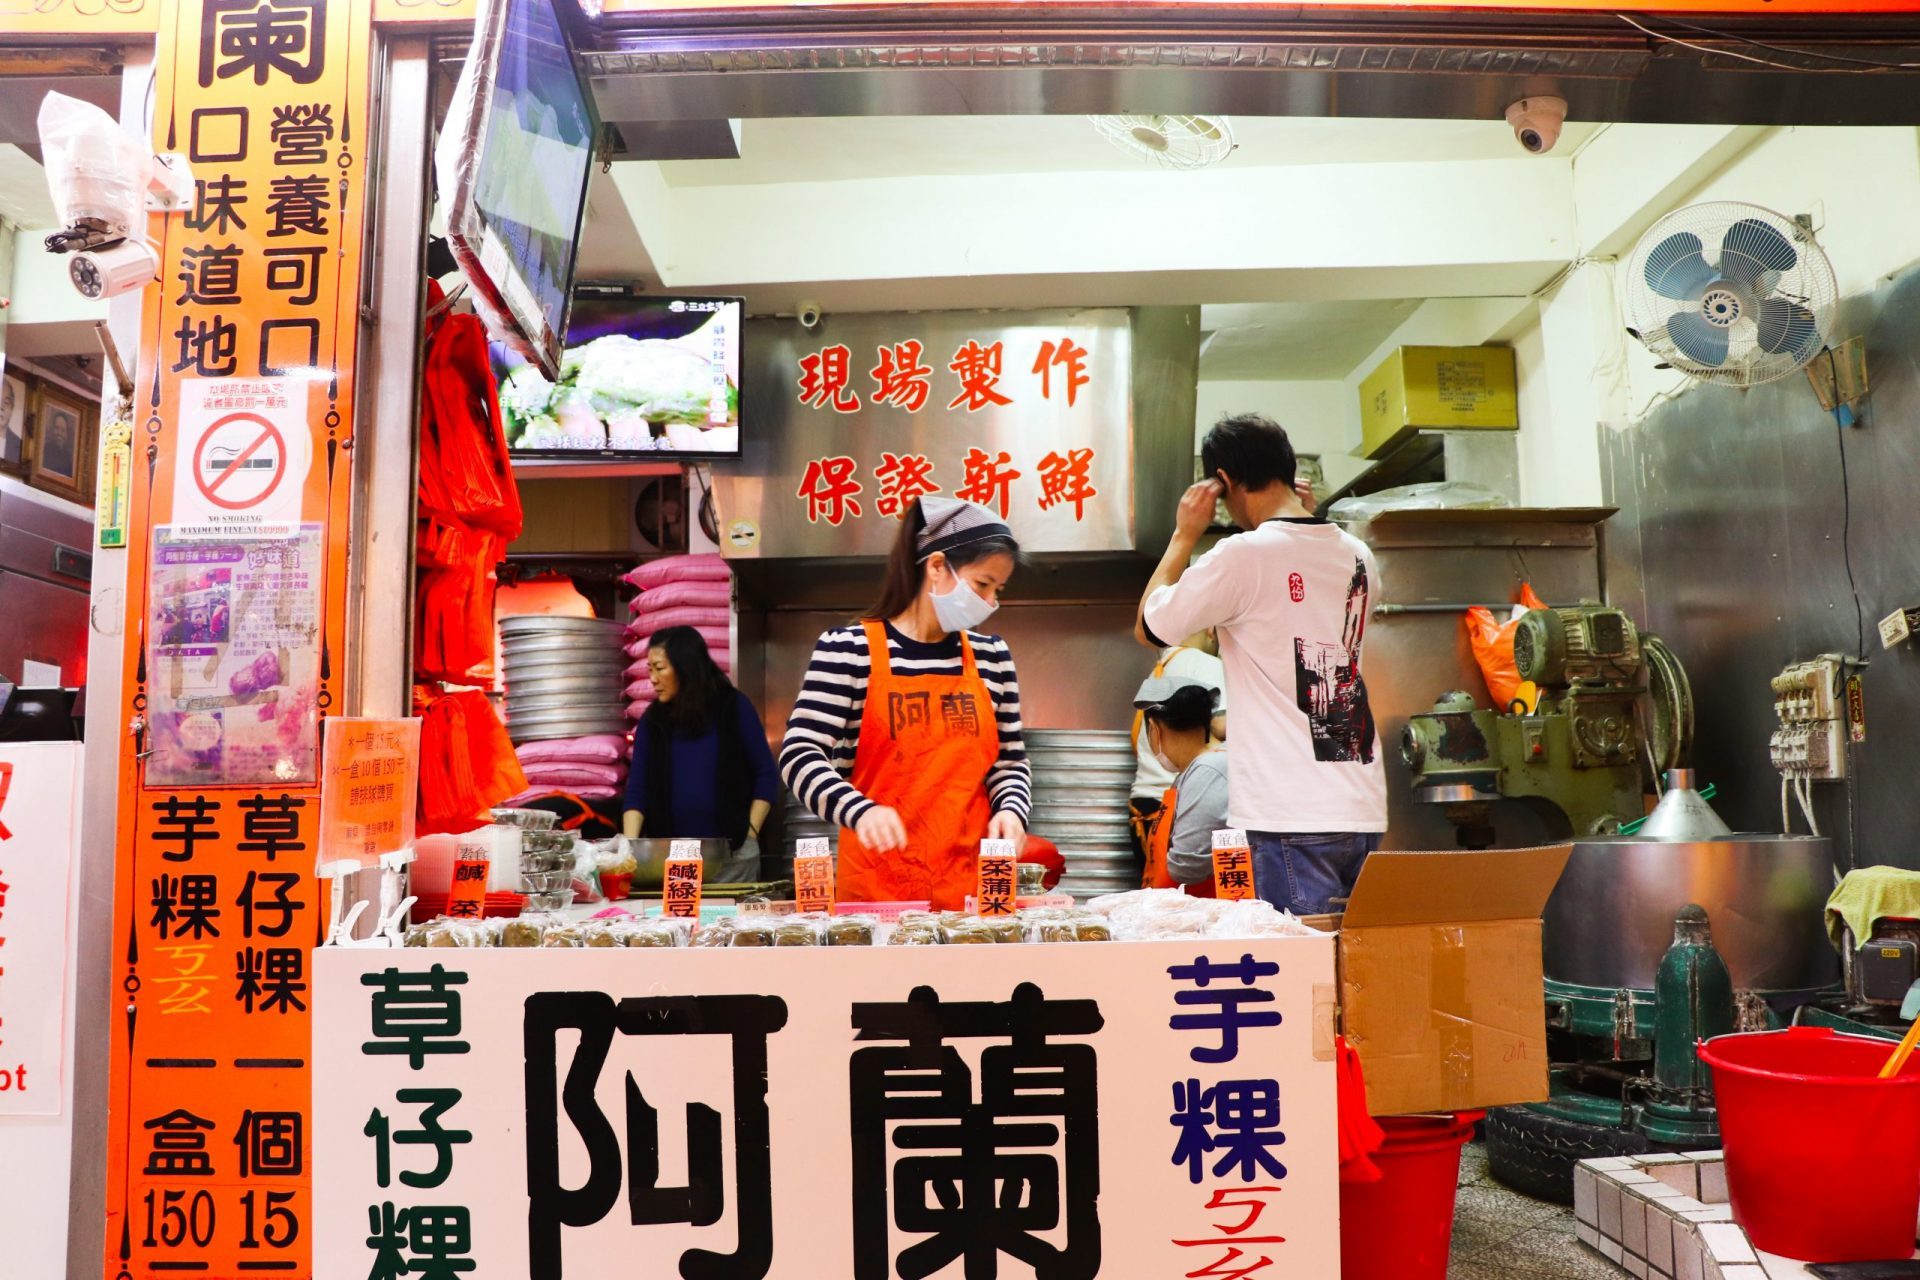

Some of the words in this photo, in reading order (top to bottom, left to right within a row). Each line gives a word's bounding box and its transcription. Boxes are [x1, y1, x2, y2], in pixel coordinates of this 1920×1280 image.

[171, 106, 250, 378] 口味道地
[260, 103, 334, 377] 營養可口
[797, 337, 1092, 413] 現場製作
[222, 515, 263, 523] SMOKING
[797, 447, 1098, 527] 保證新鮮
[180, 527, 221, 535] MAXIMUM
[247, 548, 300, 569] 好味道
[888, 691, 980, 740] 阿蘭
[235, 794, 306, 1014] 草仔粿
[667, 864, 698, 917] 鹹綠豆
[361, 963, 477, 1280] 草仔粿
[523, 981, 1105, 1280] 阿蘭
[142, 1188, 216, 1248] 150
[239, 1189, 299, 1249] 15
